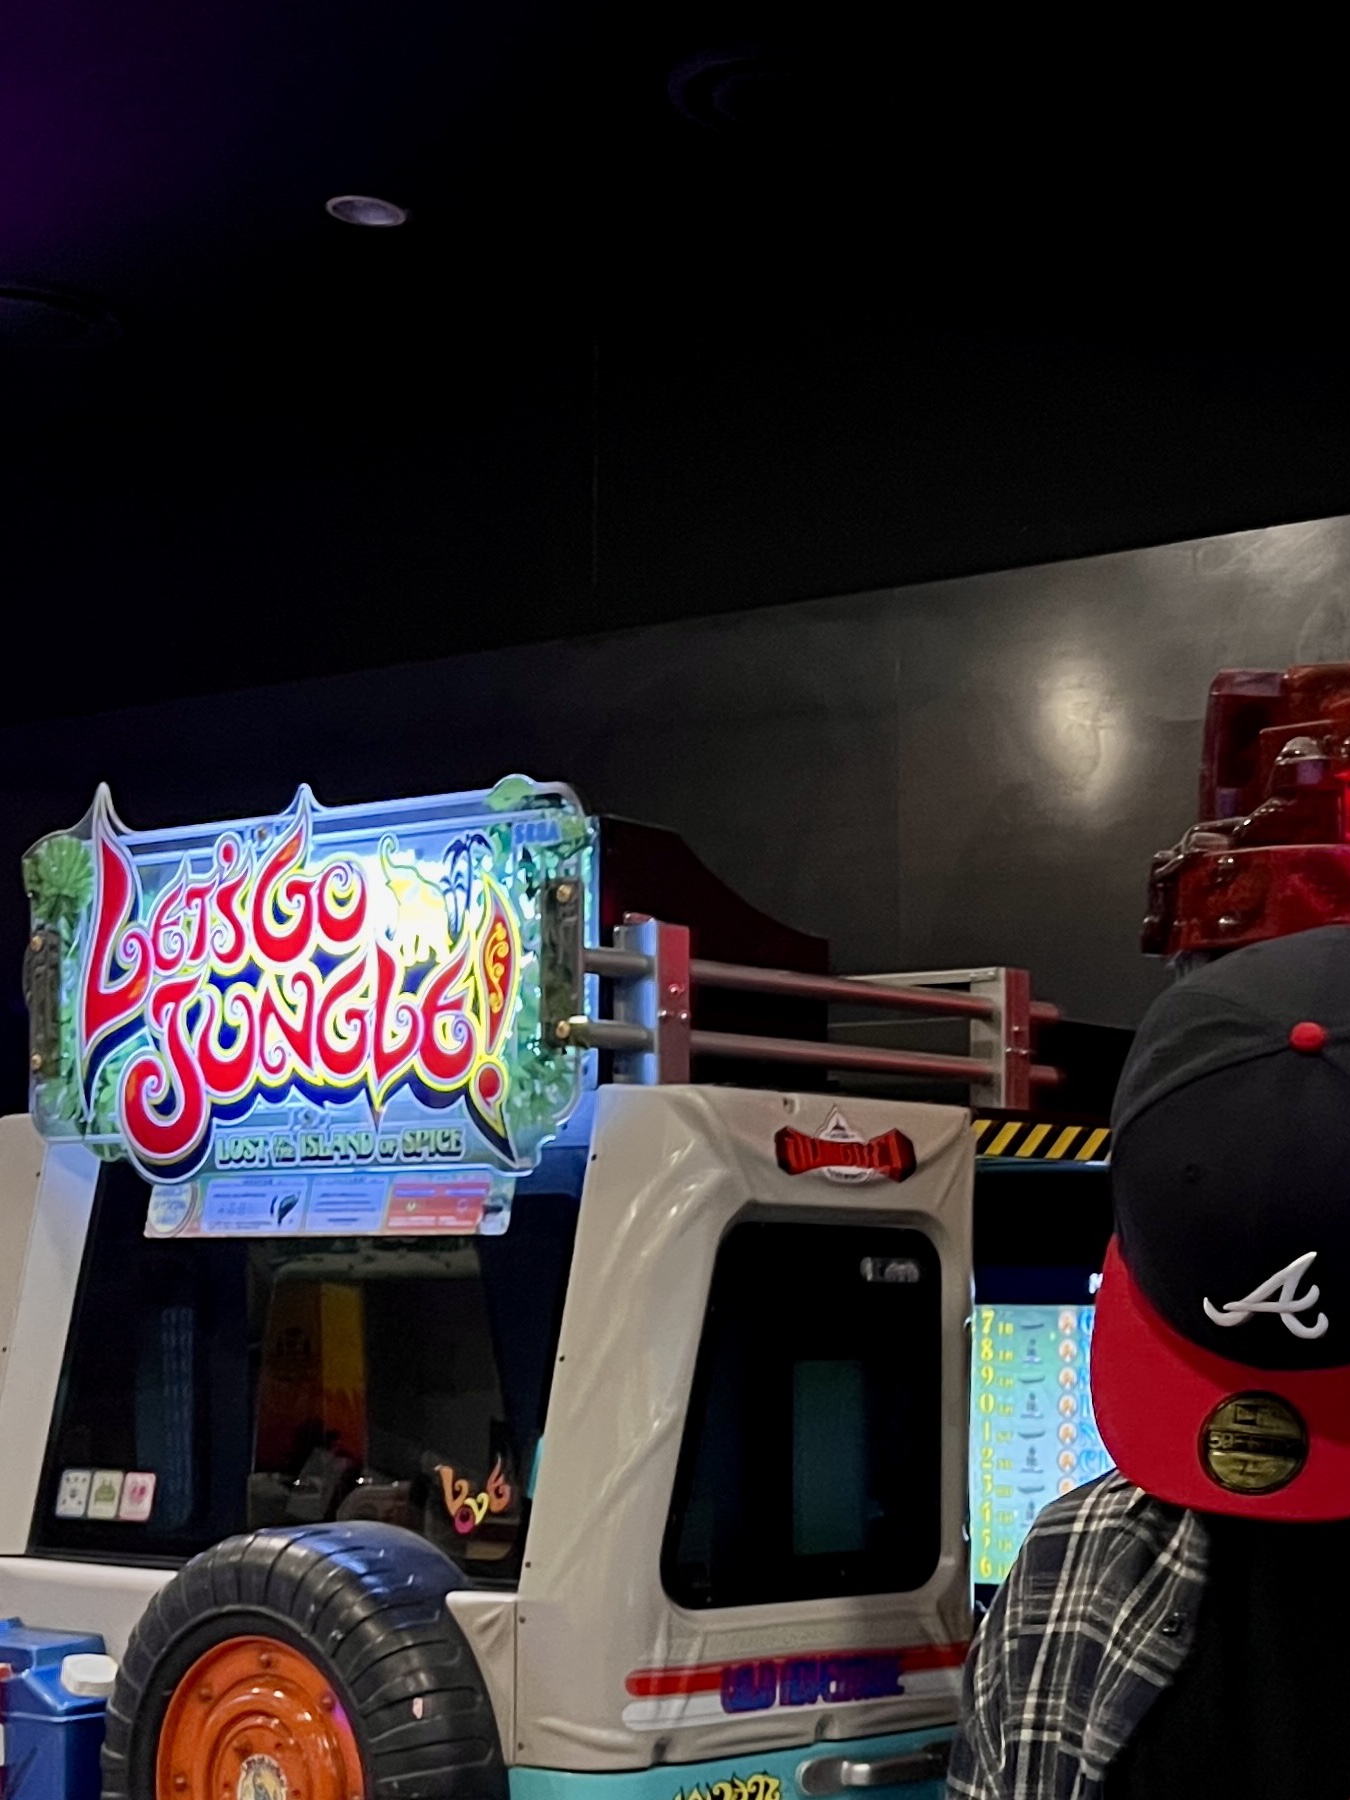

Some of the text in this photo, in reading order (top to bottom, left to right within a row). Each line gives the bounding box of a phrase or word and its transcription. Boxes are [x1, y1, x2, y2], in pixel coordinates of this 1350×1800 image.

[251, 824, 369, 965] GO
[217, 1135, 268, 1164] LOST
[301, 1131, 375, 1160] ISLAND
[379, 1139, 397, 1157] OF
[403, 1127, 463, 1157] SPICE
